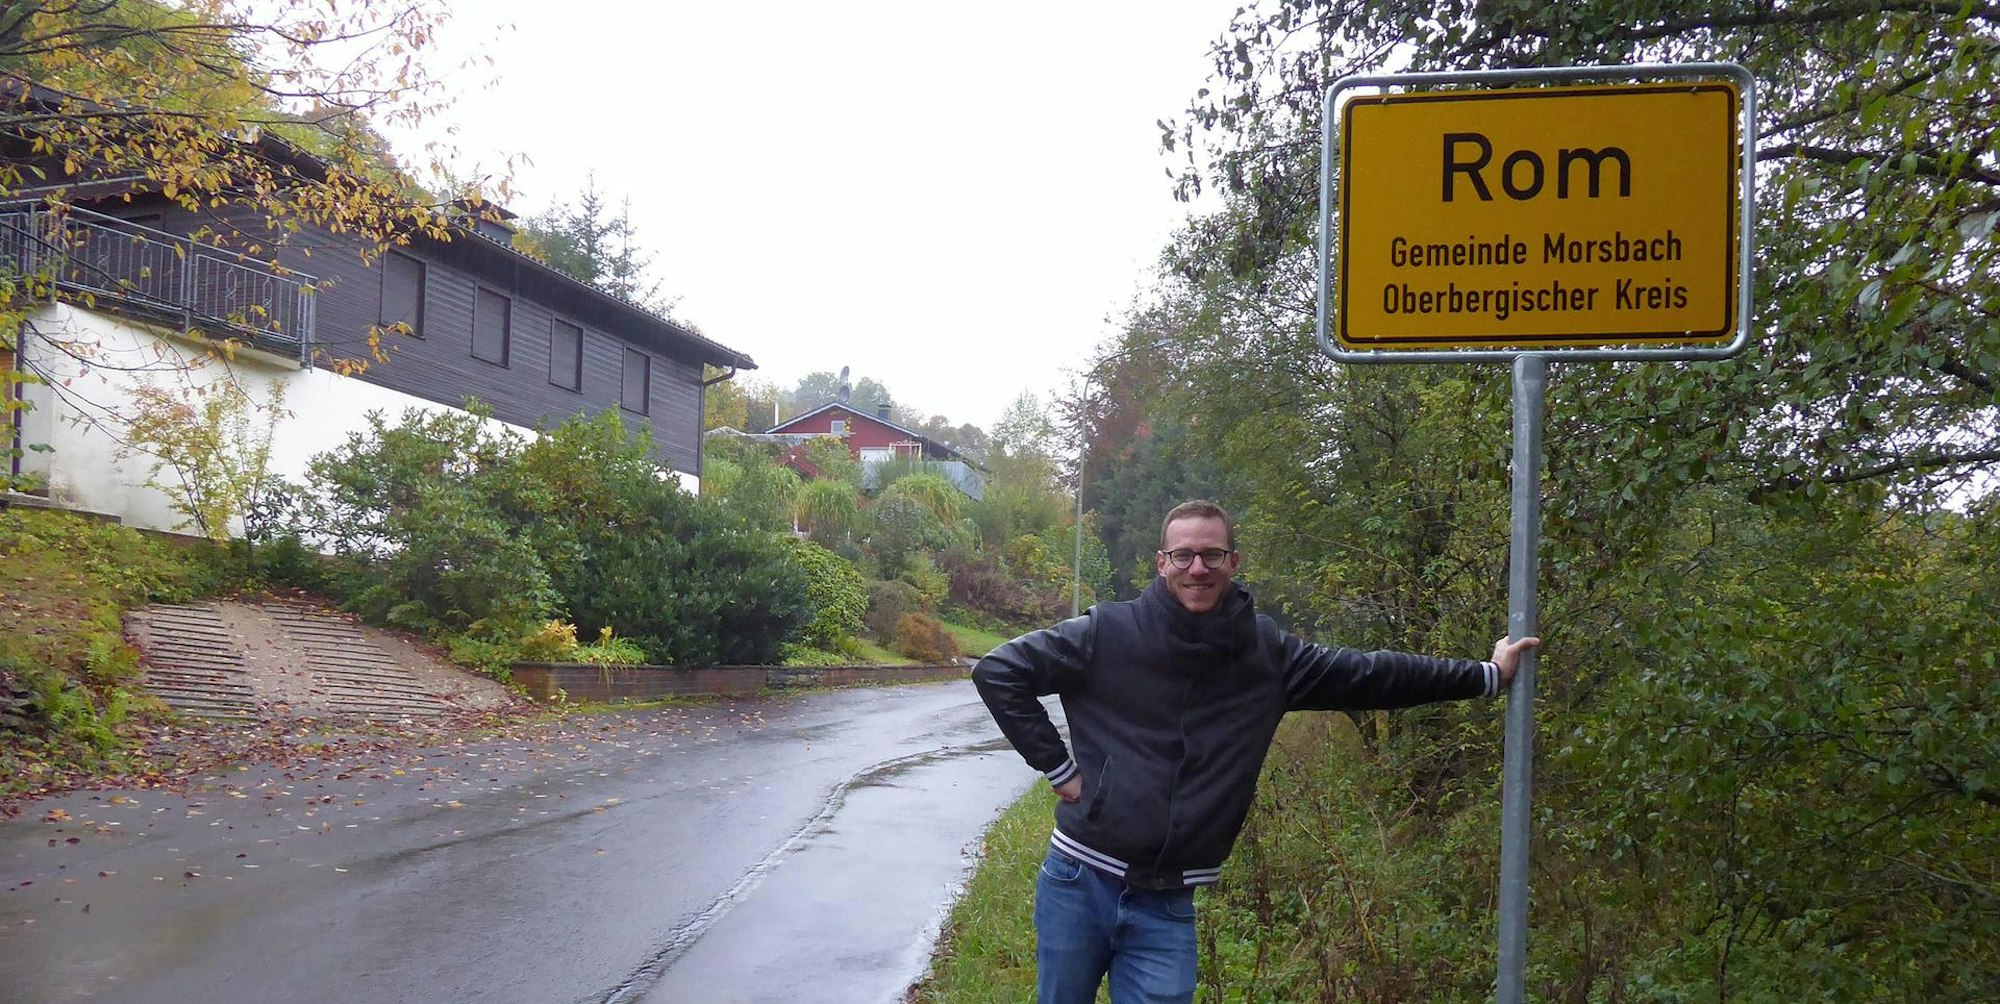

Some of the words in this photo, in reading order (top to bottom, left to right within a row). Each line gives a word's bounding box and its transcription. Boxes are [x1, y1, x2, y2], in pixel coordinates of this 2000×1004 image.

[1442, 132, 1631, 202] Rom
[1391, 234, 1527, 267] Gemeinde
[1544, 230, 1682, 264] Morsbach
[1383, 280, 1599, 321] Oberbergischer
[1616, 277, 1688, 311] Kreis
